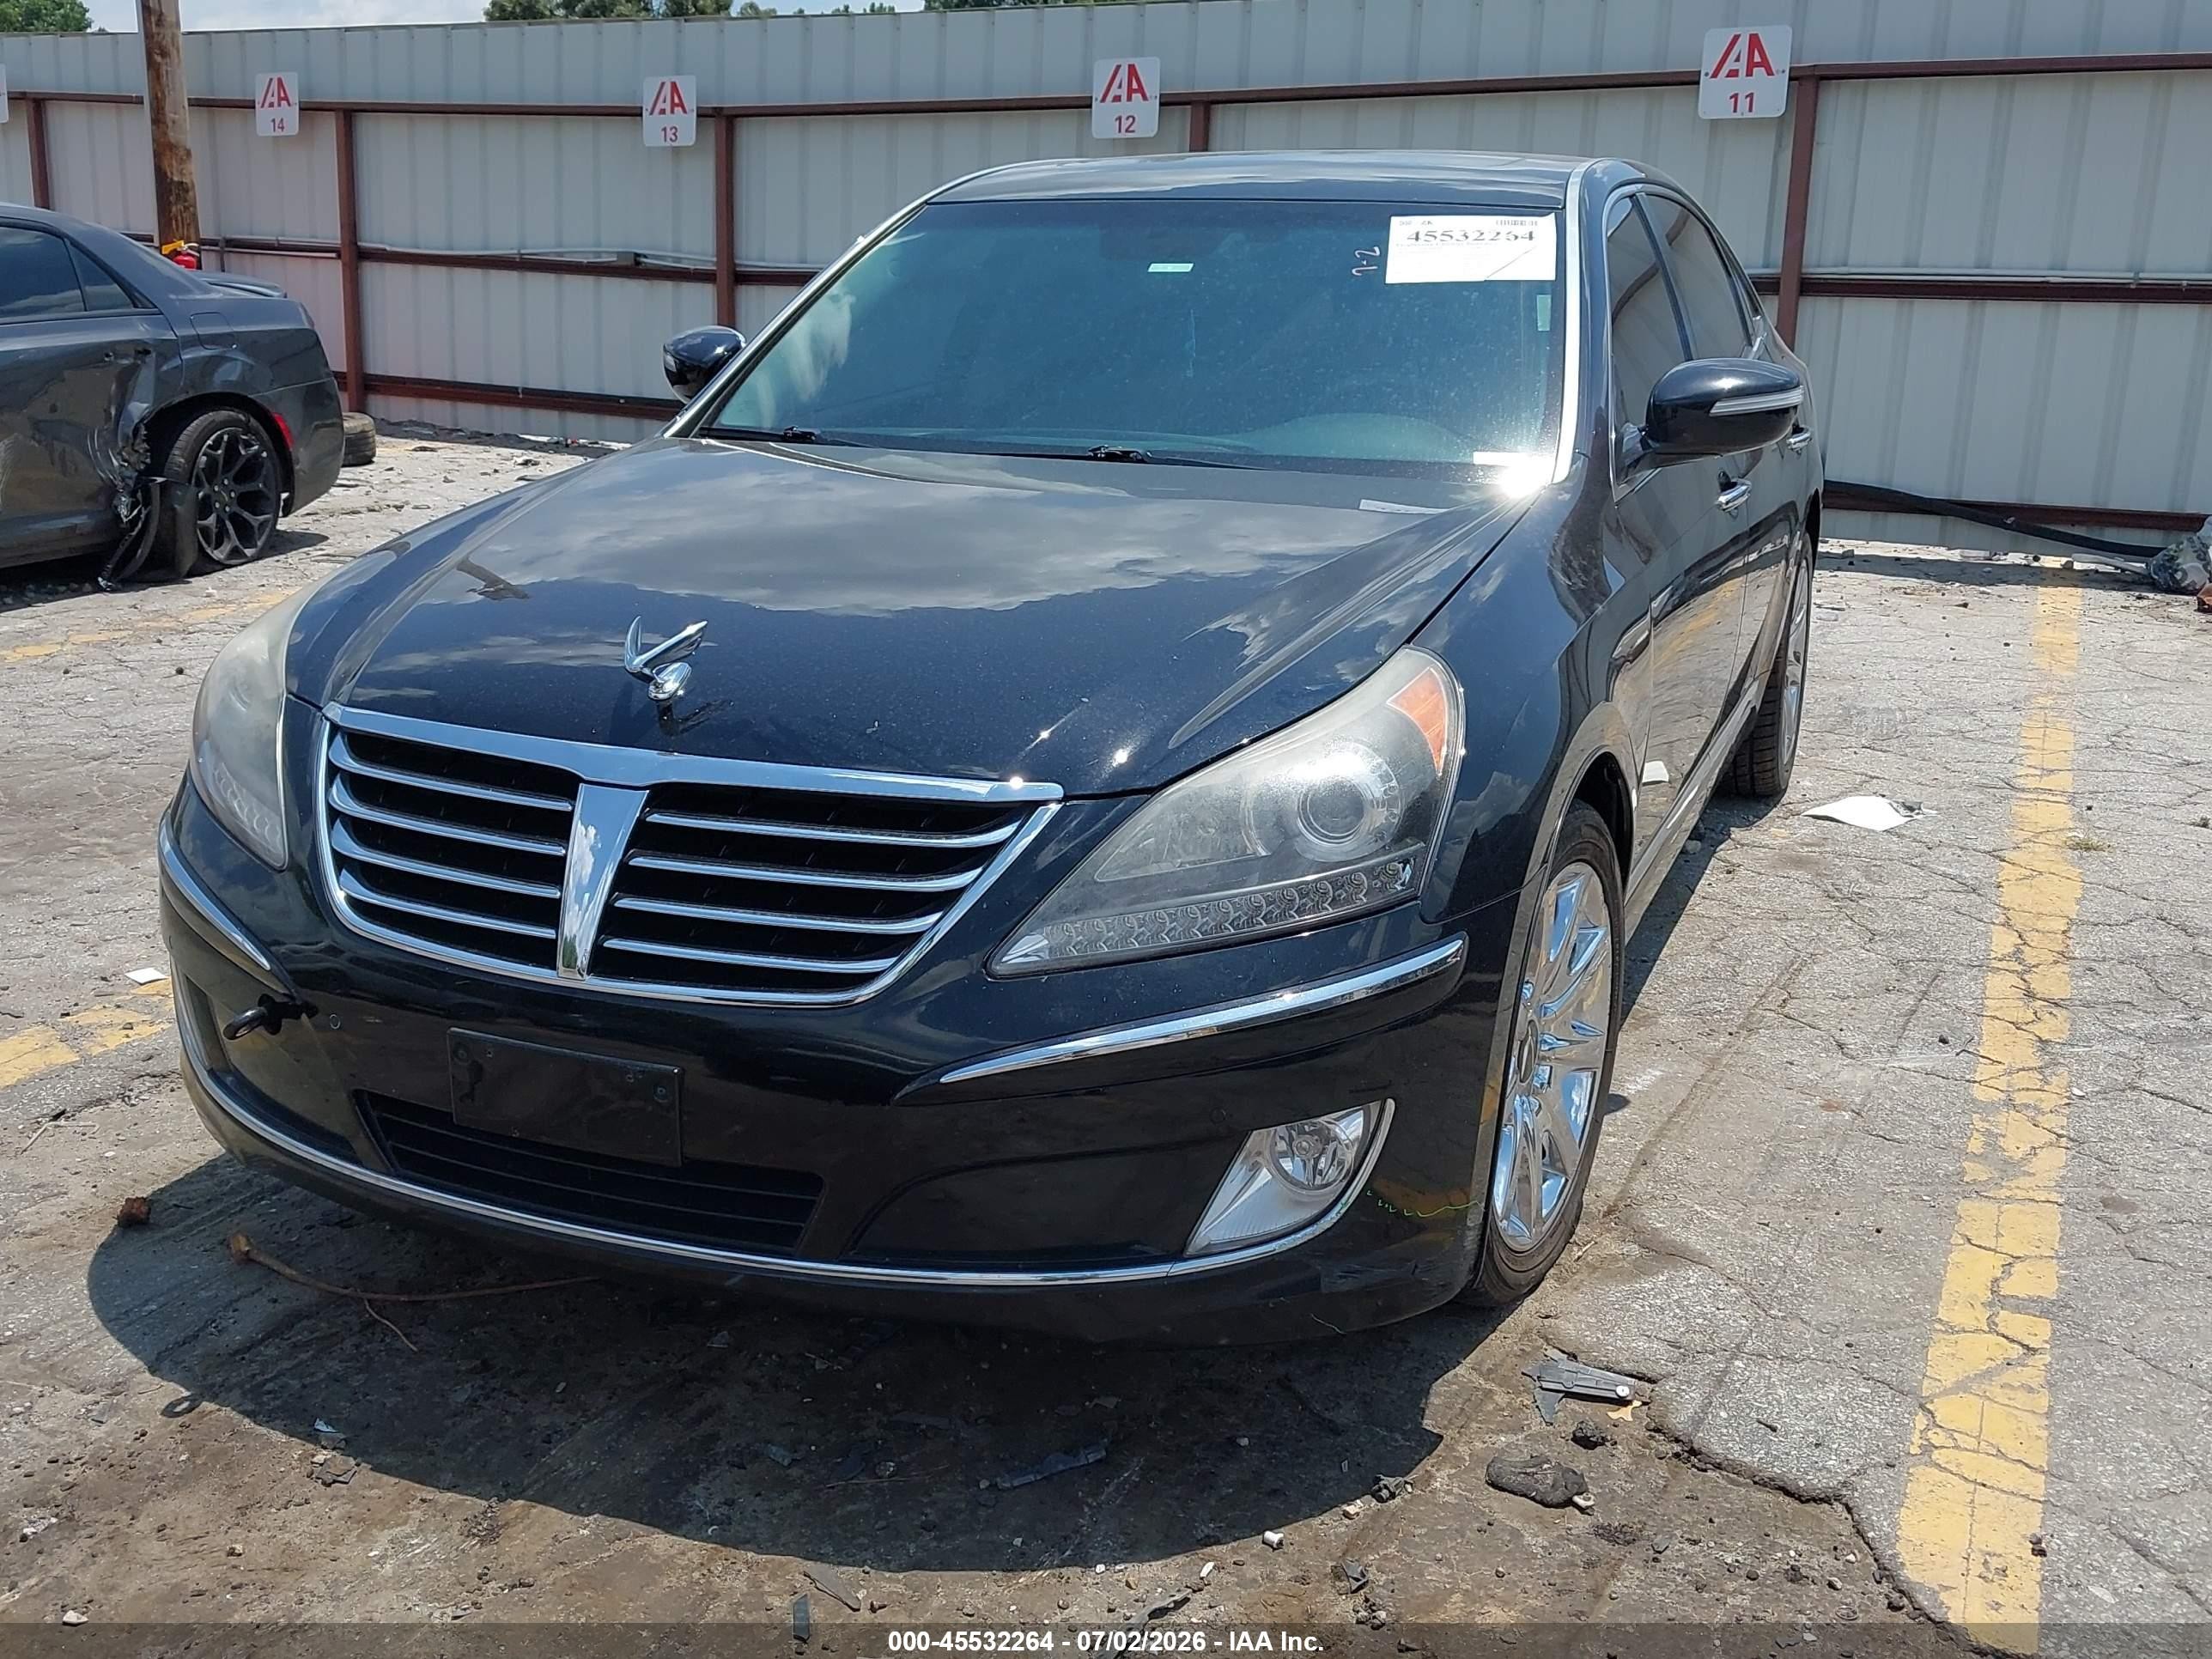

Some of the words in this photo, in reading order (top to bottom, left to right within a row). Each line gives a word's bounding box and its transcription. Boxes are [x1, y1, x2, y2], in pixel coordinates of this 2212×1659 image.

[1729, 92, 1755, 113] 11
[270, 117, 285, 132] 14
[1115, 114, 1136, 134] 12
[661, 125, 678, 143] 13
